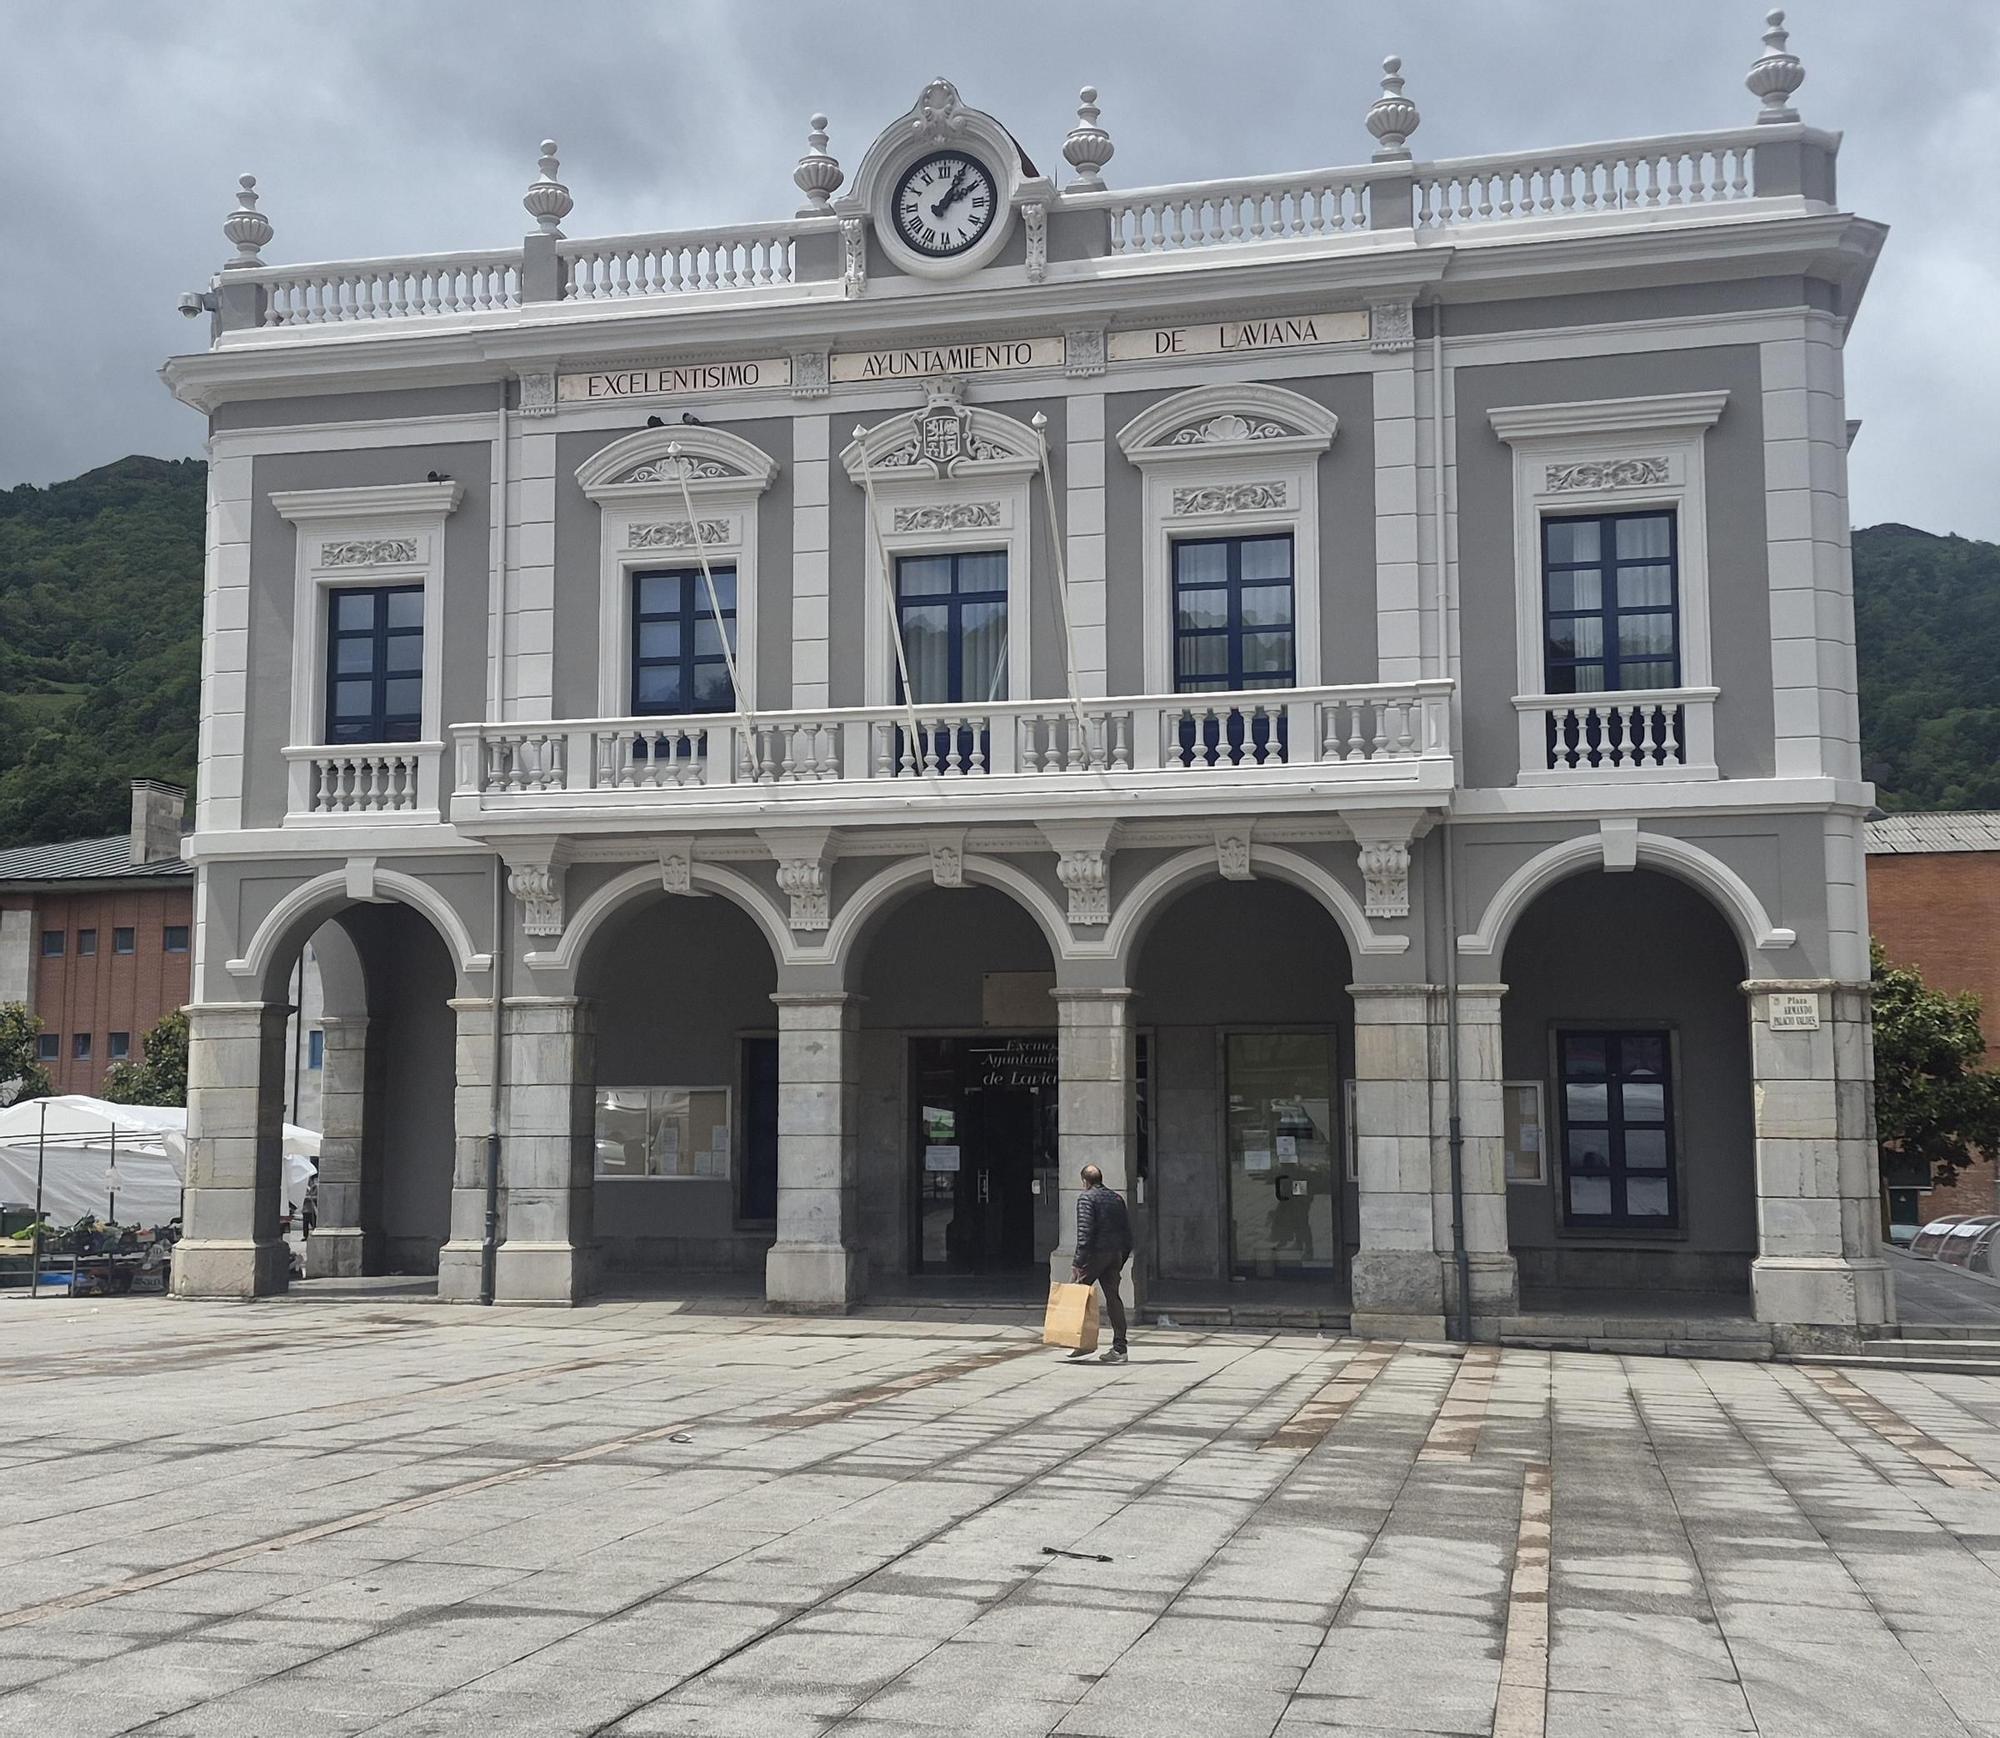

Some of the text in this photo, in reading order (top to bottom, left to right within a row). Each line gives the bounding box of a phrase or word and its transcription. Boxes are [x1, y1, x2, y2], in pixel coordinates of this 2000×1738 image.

[938, 166, 951, 179] XII
[972, 197, 984, 208] III
[1155, 319, 1319, 354] DE LAVIANA
[862, 343, 1032, 377] AYUNTAMIENTO
[587, 364, 759, 397] EXCELENTISIMO
[981, 1053, 1059, 1068] Ayuntamie
[983, 1071, 1058, 1085] de Lavia
